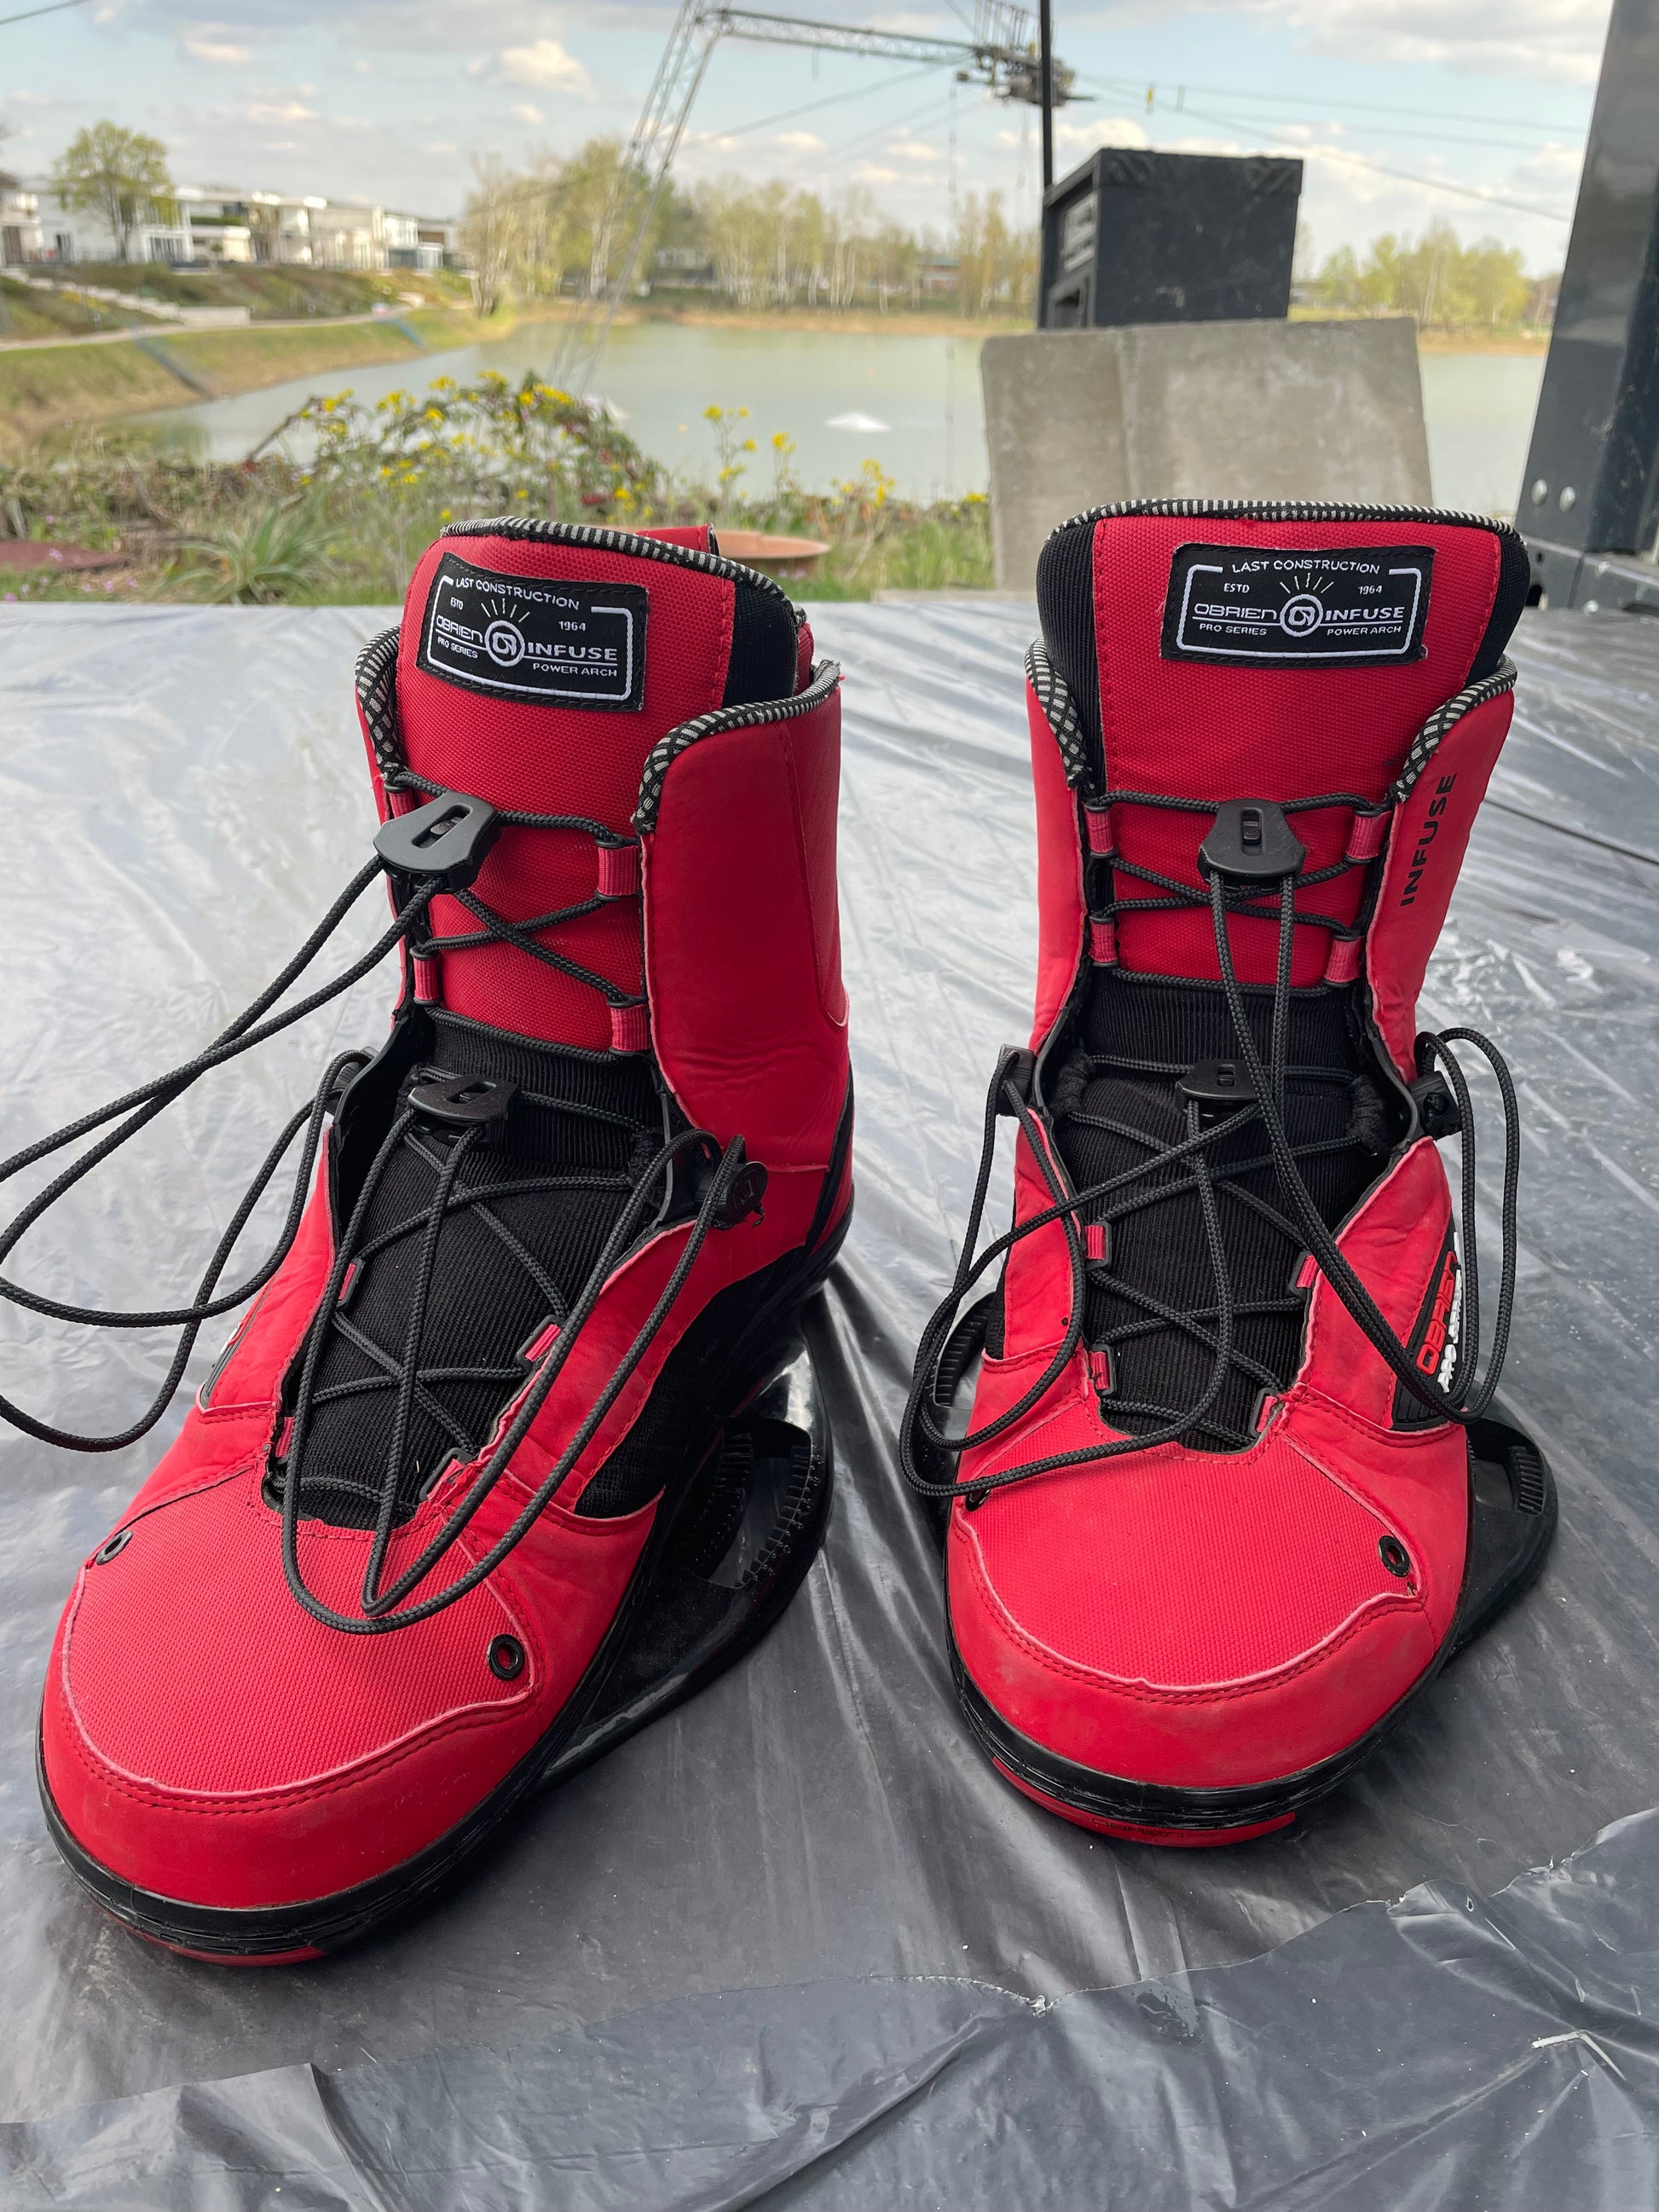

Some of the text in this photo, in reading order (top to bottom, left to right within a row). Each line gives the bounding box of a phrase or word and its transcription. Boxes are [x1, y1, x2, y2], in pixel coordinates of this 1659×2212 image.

[1232, 559, 1380, 574] LAST CONSTRUCTION
[455, 578, 581, 610] LAST CONSTRUCTION
[1223, 583, 1250, 593] ESTD
[1358, 585, 1383, 595] 1964
[1194, 603, 1277, 621] OBRIEN
[1325, 606, 1405, 621] INFUSE
[436, 614, 483, 644] OBRIEN
[558, 621, 587, 632] 1964
[1199, 623, 1268, 636] PRO SERIES
[1327, 626, 1402, 636] POWER ARCH
[437, 637, 478, 659] PRO SERIES
[528, 642, 618, 661] INFUSE
[533, 662, 617, 677] POWER ARCH
[1400, 773, 1457, 906] INFUSE
